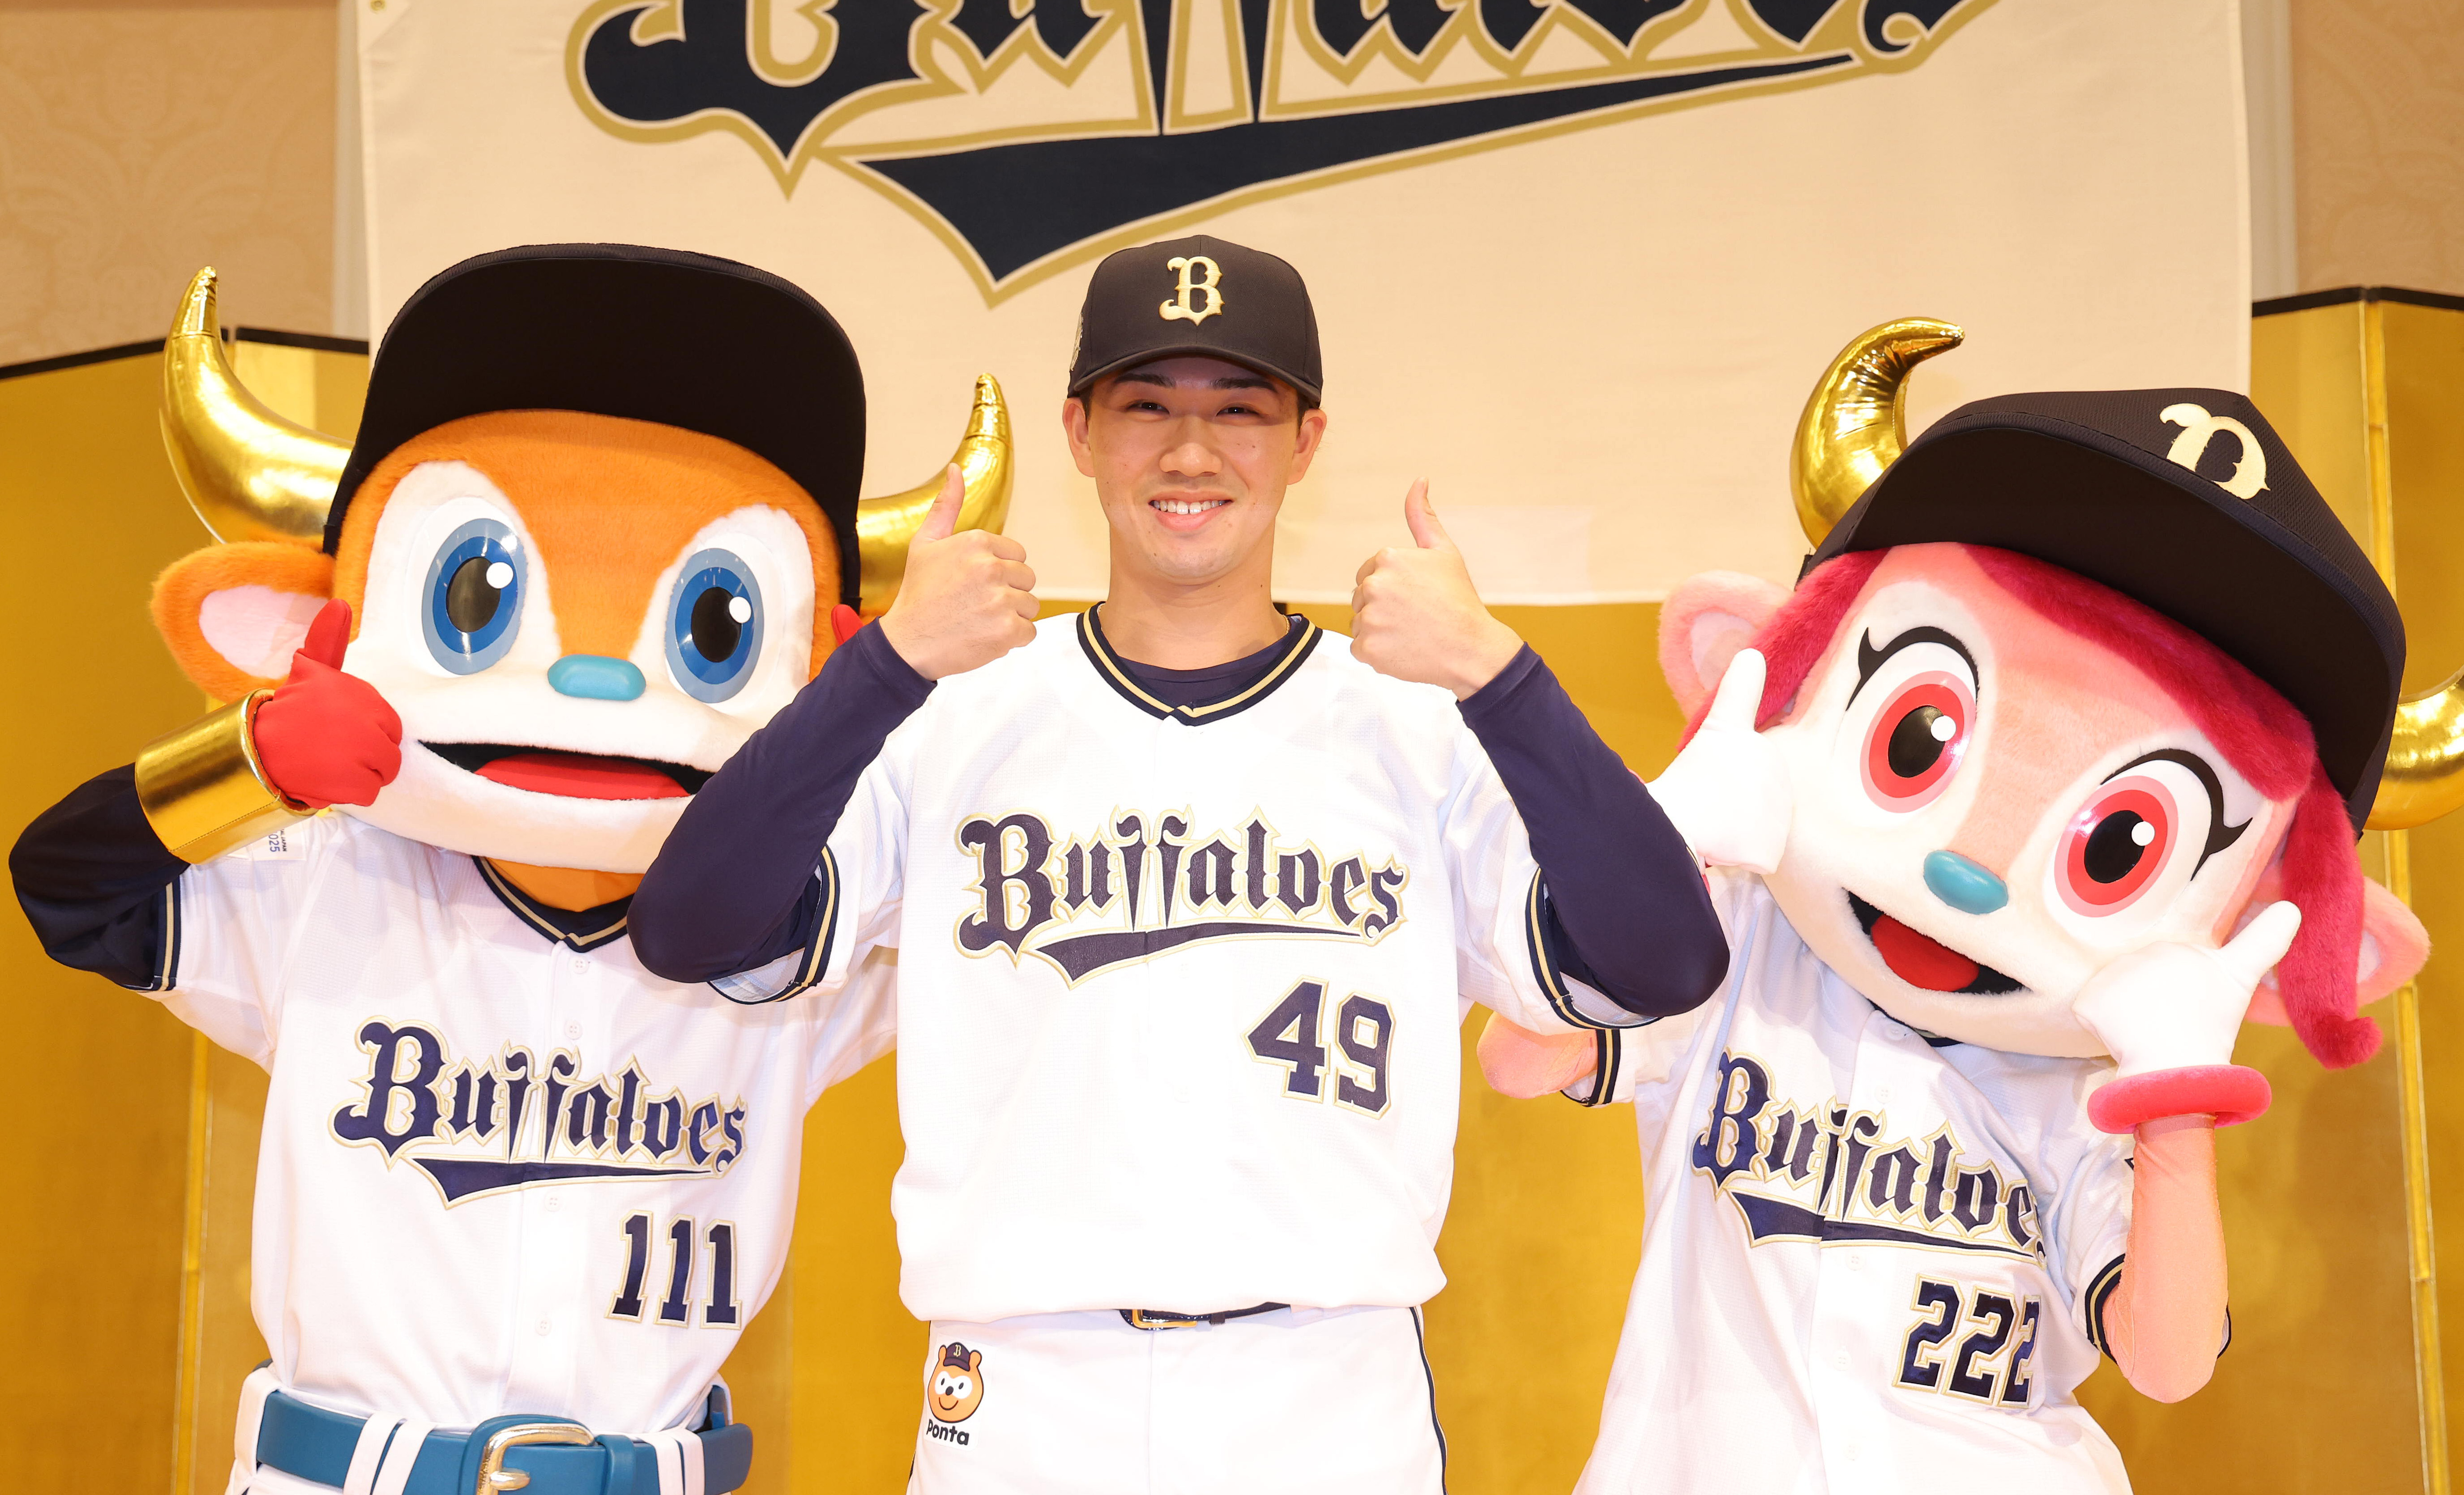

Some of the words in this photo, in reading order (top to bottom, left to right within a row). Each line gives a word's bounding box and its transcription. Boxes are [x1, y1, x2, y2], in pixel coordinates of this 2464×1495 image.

[1158, 256, 1225, 326] B
[269, 834, 280, 852] 025
[953, 804, 1409, 971] Buffaloes
[328, 1014, 747, 1179] Buffaloes
[1240, 974, 1396, 1120] 49
[1691, 1046, 2047, 1271] Buffaloe
[604, 1209, 742, 1330] 111
[1892, 1272, 2041, 1409] 222
[926, 1418, 970, 1446] Ponta
